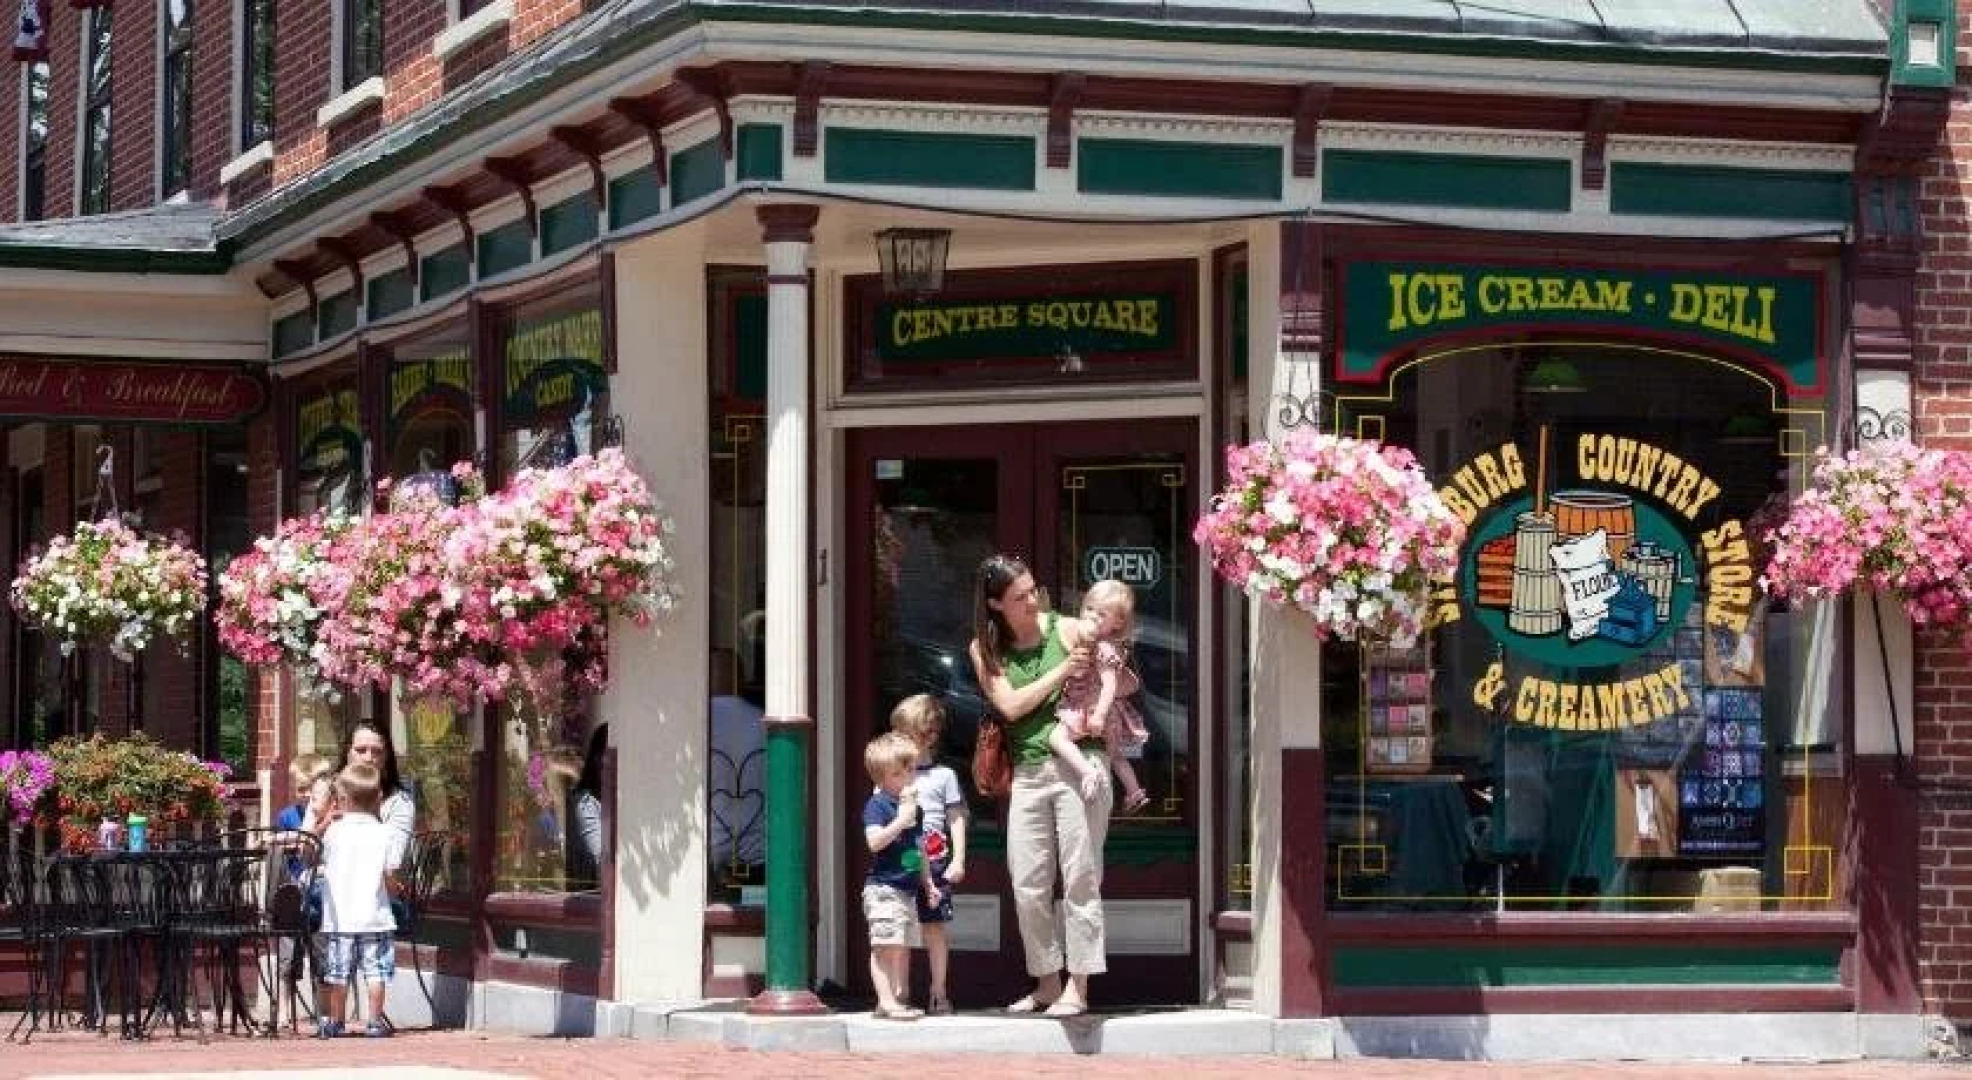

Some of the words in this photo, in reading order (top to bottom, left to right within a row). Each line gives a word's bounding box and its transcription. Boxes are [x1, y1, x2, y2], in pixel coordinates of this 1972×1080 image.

[893, 304, 1018, 346] CENTRE
[1027, 299, 1159, 337] SQUARE
[1389, 272, 1466, 331] ICE
[1478, 276, 1633, 313] CREAM
[1669, 283, 1777, 344] DELI
[106, 367, 233, 417] Breakfast
[1578, 433, 1722, 520] COUNTRY
[1701, 519, 1753, 634] STORE
[1091, 552, 1155, 581] OPEN
[1473, 661, 1509, 711] &
[1515, 663, 1690, 732] CREAMERY
